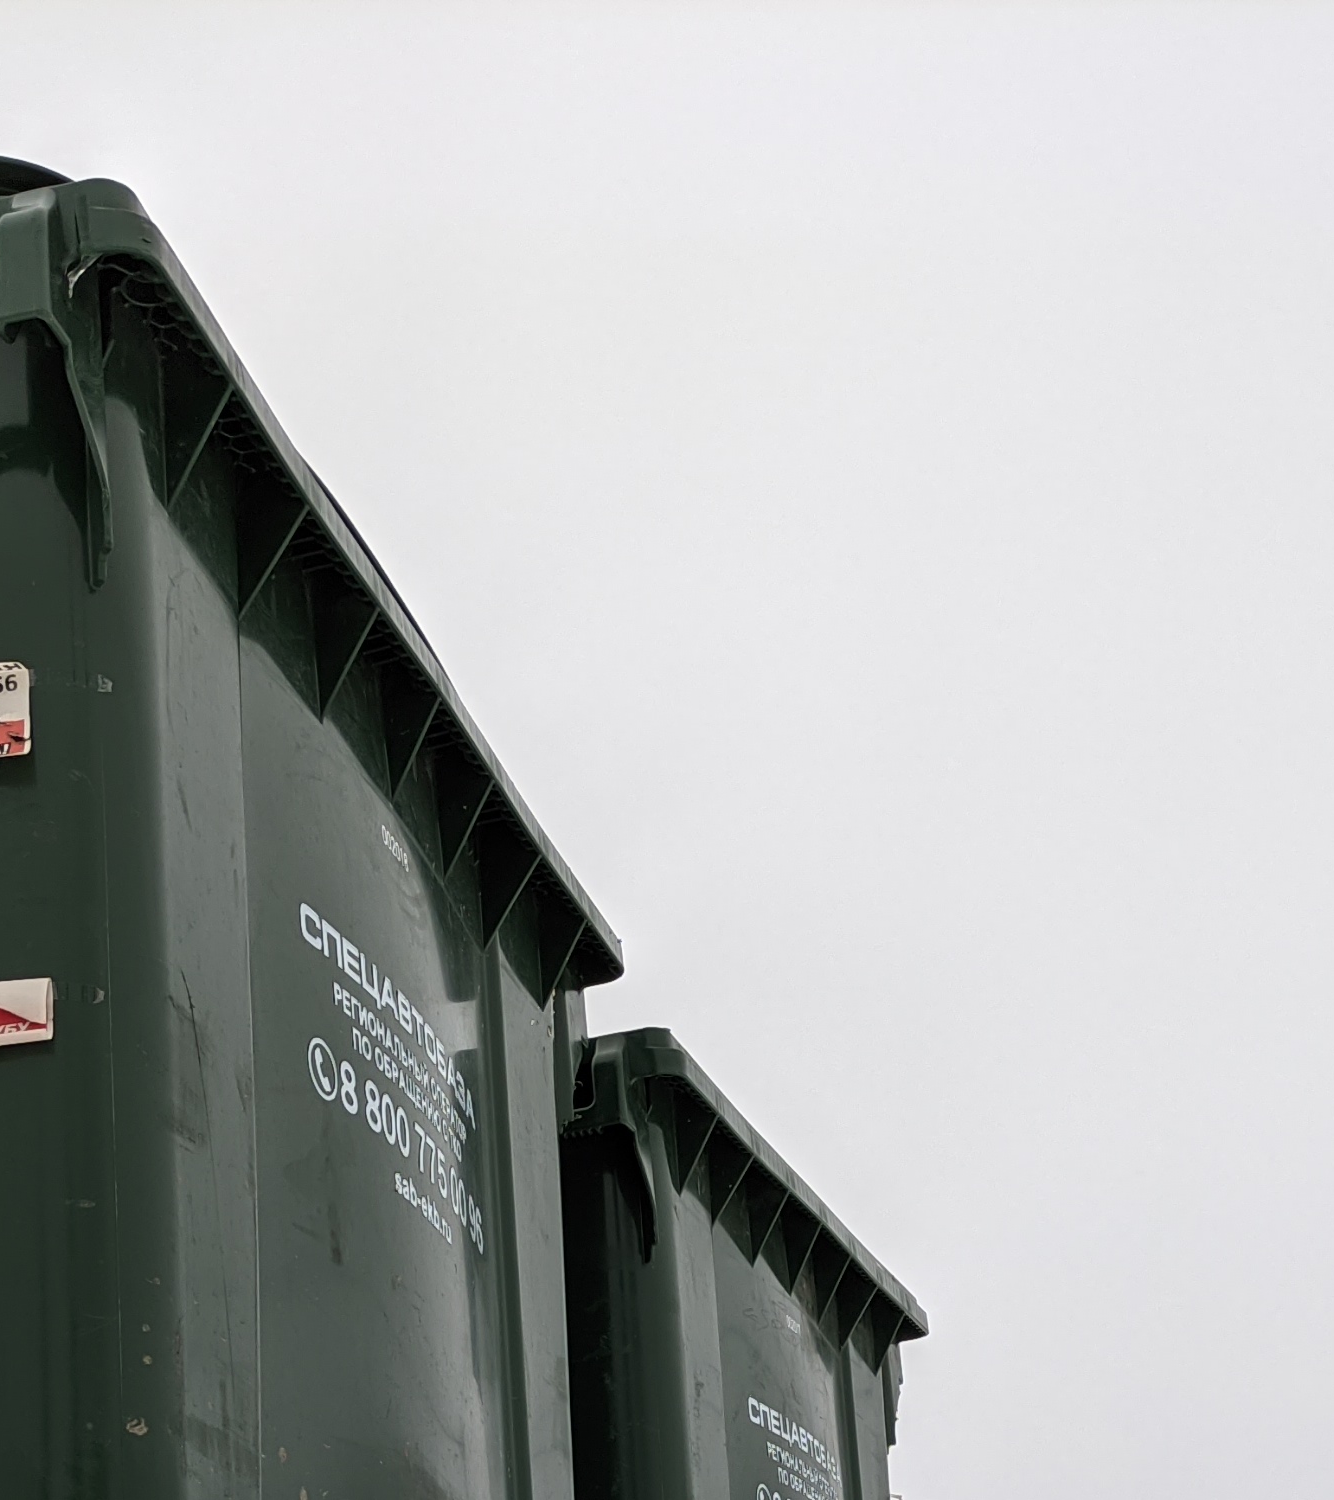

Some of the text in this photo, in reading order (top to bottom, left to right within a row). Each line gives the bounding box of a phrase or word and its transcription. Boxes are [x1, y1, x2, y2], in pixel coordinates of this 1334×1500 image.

[299, 901, 477, 1131] СПЕЦАВТОБАЗА
[332, 981, 467, 1146] РЕГИОНАЛЬНЫЙ ОПЕРАТОР
[352, 1027, 373, 1062] ПО
[374, 1046, 442, 1134] ОБРАЩЕНИЮ
[340, 1060, 484, 1255] 8 800 775 00 96
[394, 1172, 453, 1245] sab-ekb.ru
